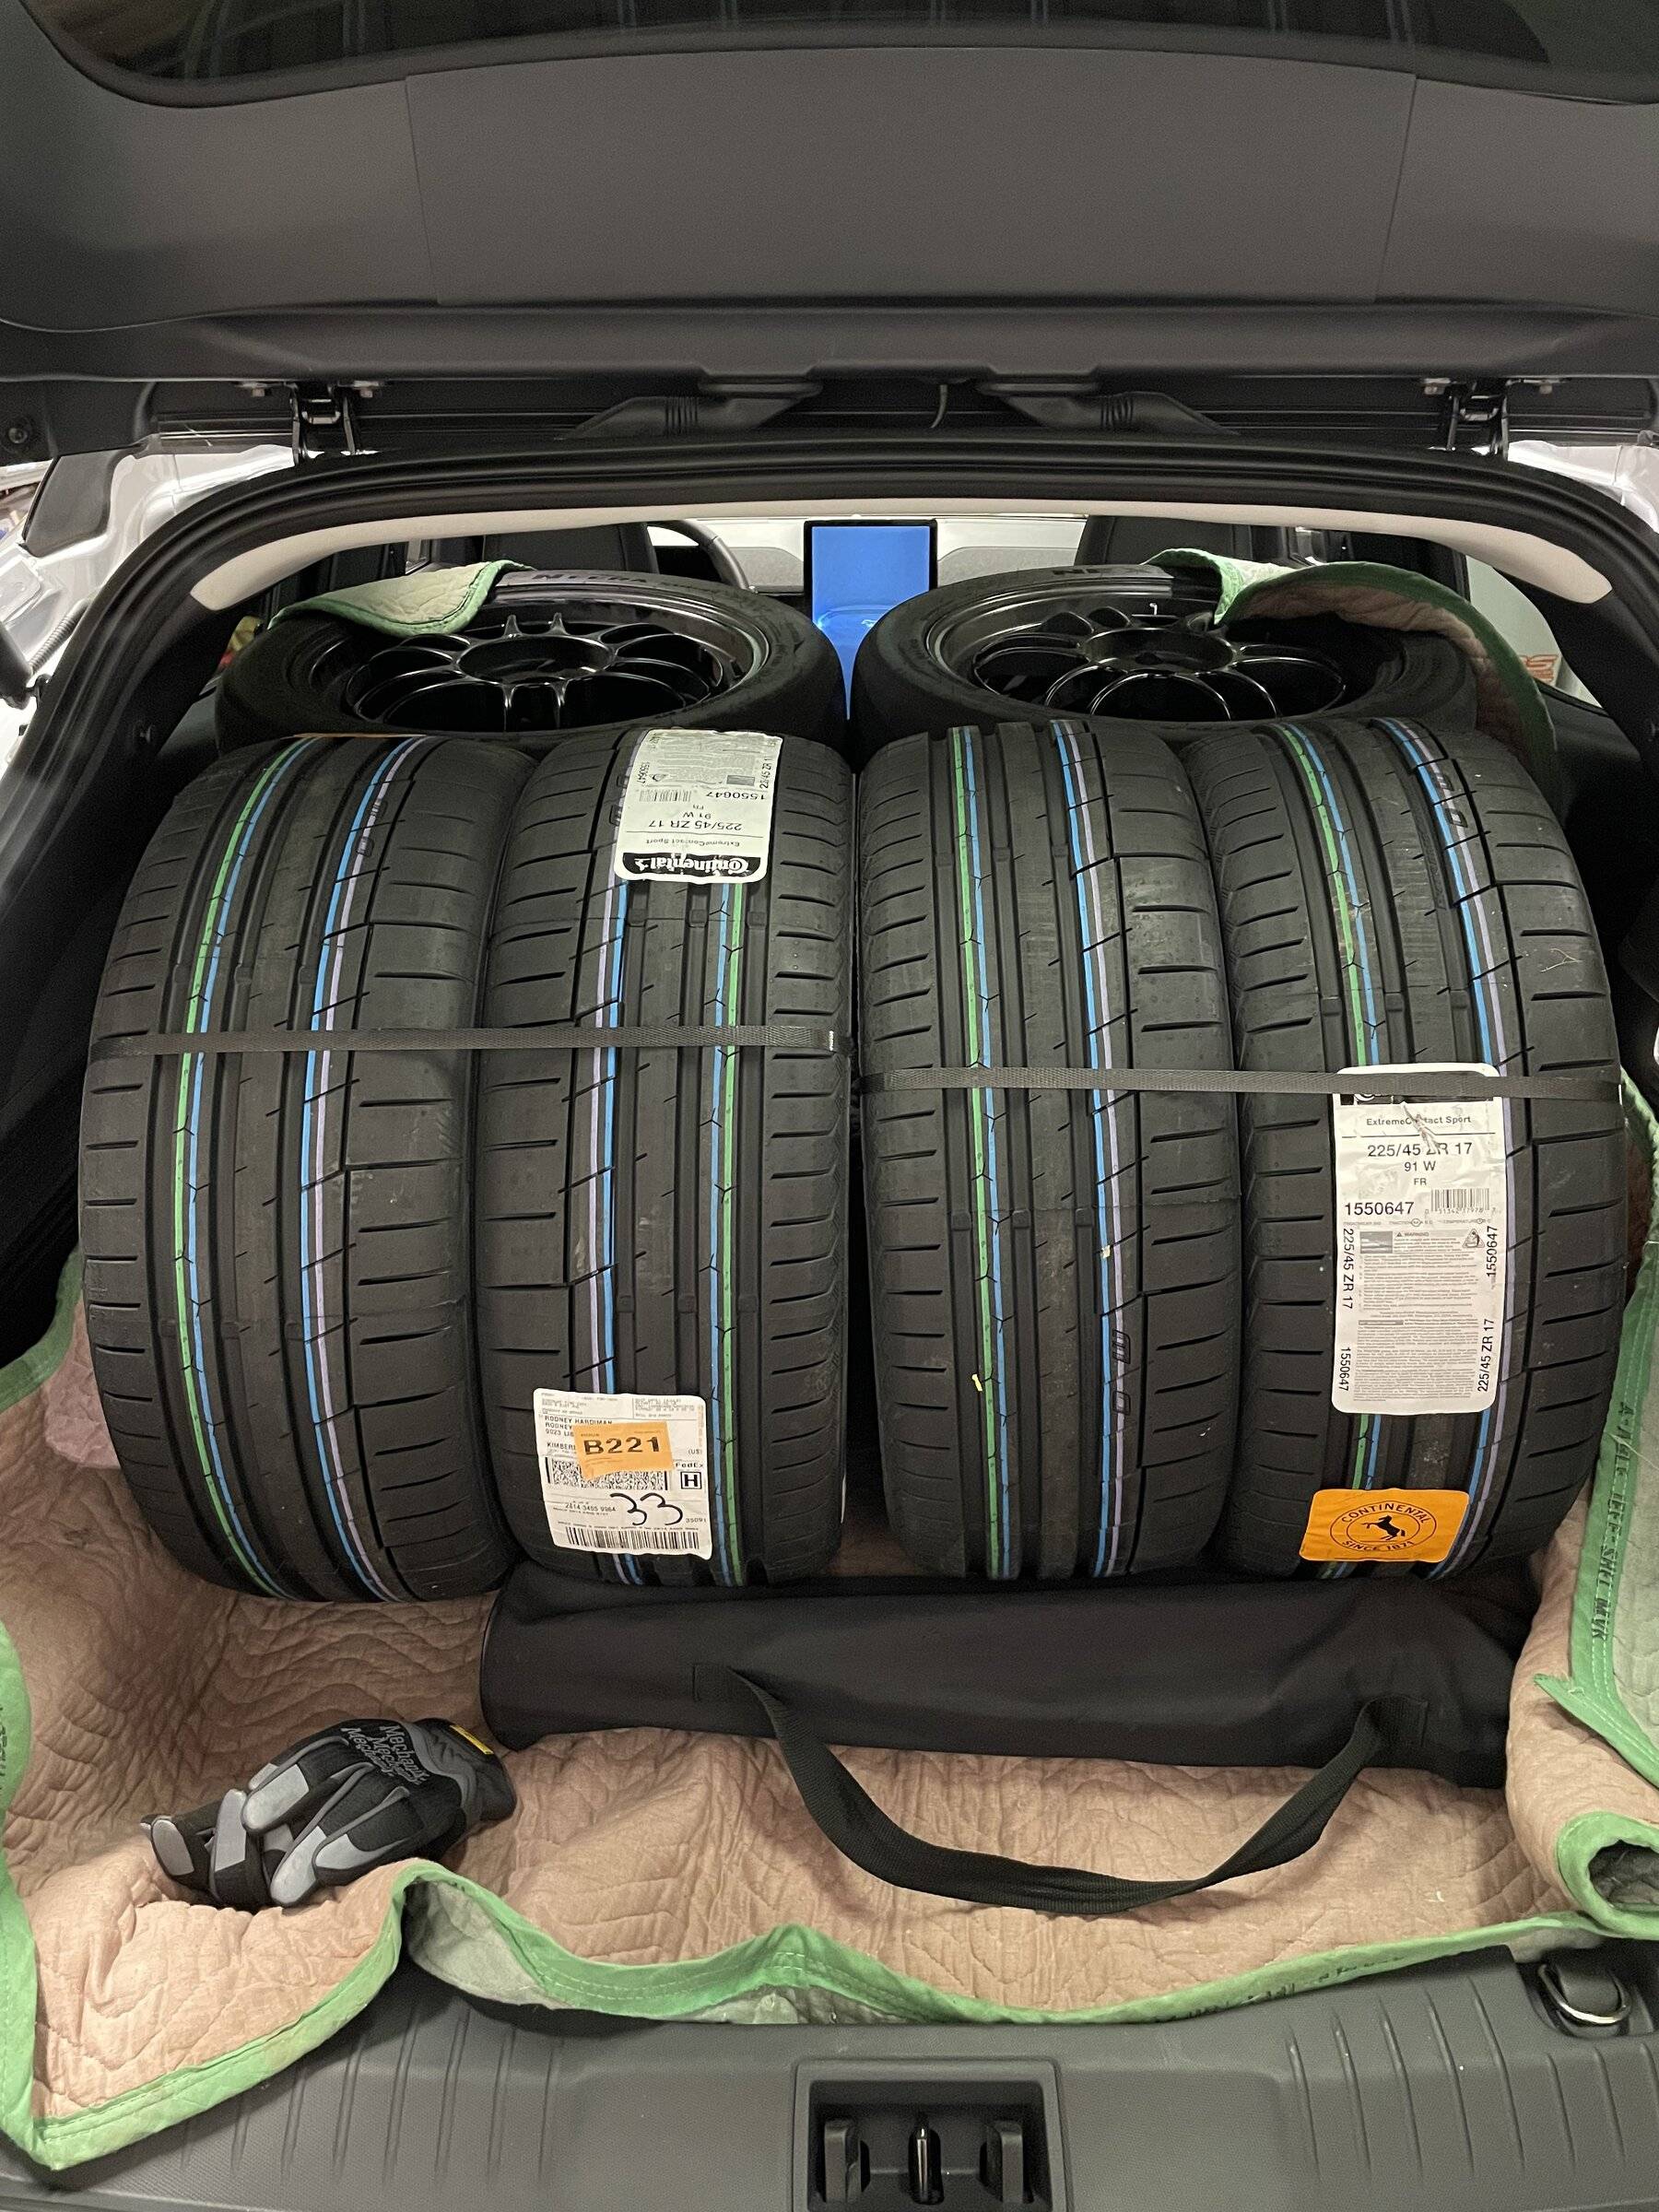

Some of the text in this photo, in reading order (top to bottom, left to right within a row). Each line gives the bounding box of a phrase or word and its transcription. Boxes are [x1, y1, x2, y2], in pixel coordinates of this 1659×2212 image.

[706, 792, 767, 801] 1550647
[649, 819, 743, 831] 225/45 ZR 17
[1366, 1115, 1472, 1126] ExtremeCtact Sport
[1367, 1144, 1421, 1158] 225/45
[1455, 1143, 1473, 1155] 17
[1404, 1160, 1436, 1171] 91 W
[1414, 1178, 1428, 1186] FR
[1344, 1201, 1415, 1216] 1550647
[1486, 1226, 1499, 1277] 1550647
[1342, 1229, 1355, 1310] 225/45 ZR 17
[1477, 1319, 1494, 1393] 225/45 ZR 17
[1339, 1347, 1352, 1392] 1550647
[545, 1415, 572, 1424] RODNEY
[583, 1436, 661, 1455] B221
[684, 1475, 699, 1487] H
[609, 1492, 683, 1526] 33
[1342, 1502, 1431, 1524] CONTINENTAL
[1342, 1540, 1382, 1551] SINCE
